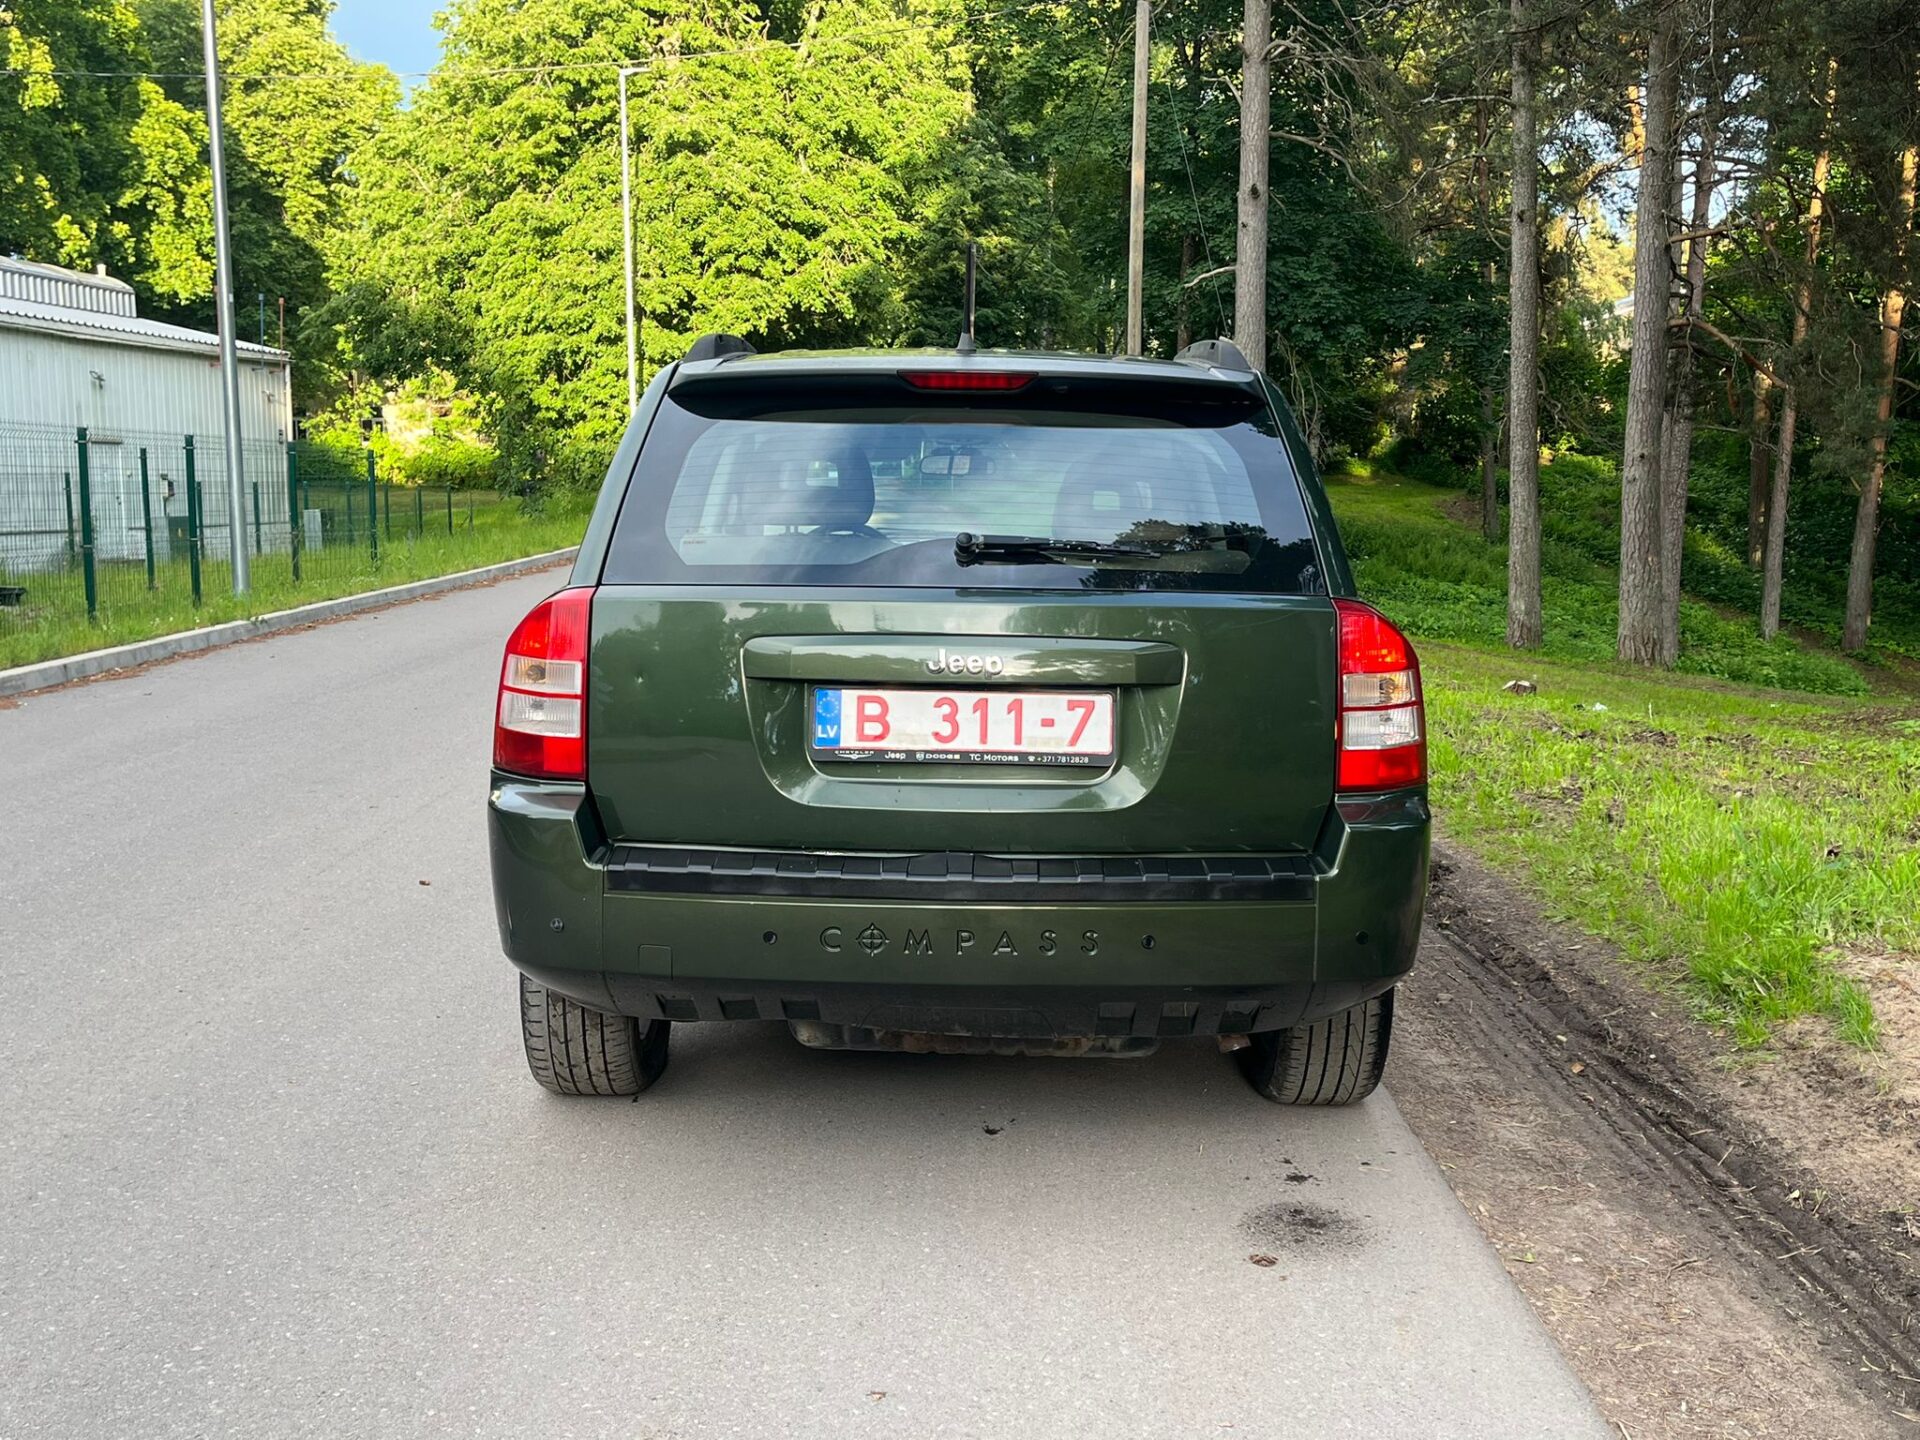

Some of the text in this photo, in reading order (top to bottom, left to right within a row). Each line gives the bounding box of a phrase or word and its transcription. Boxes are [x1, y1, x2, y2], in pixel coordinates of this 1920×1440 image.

[925, 649, 1004, 679] Jeep
[855, 694, 1096, 747] B 311-7
[817, 725, 838, 738] LV
[884, 751, 907, 760] Jeep
[969, 753, 1019, 762] TC MOTORS
[1057, 756, 1089, 764] 7812828
[819, 922, 1100, 957] COMPASS
